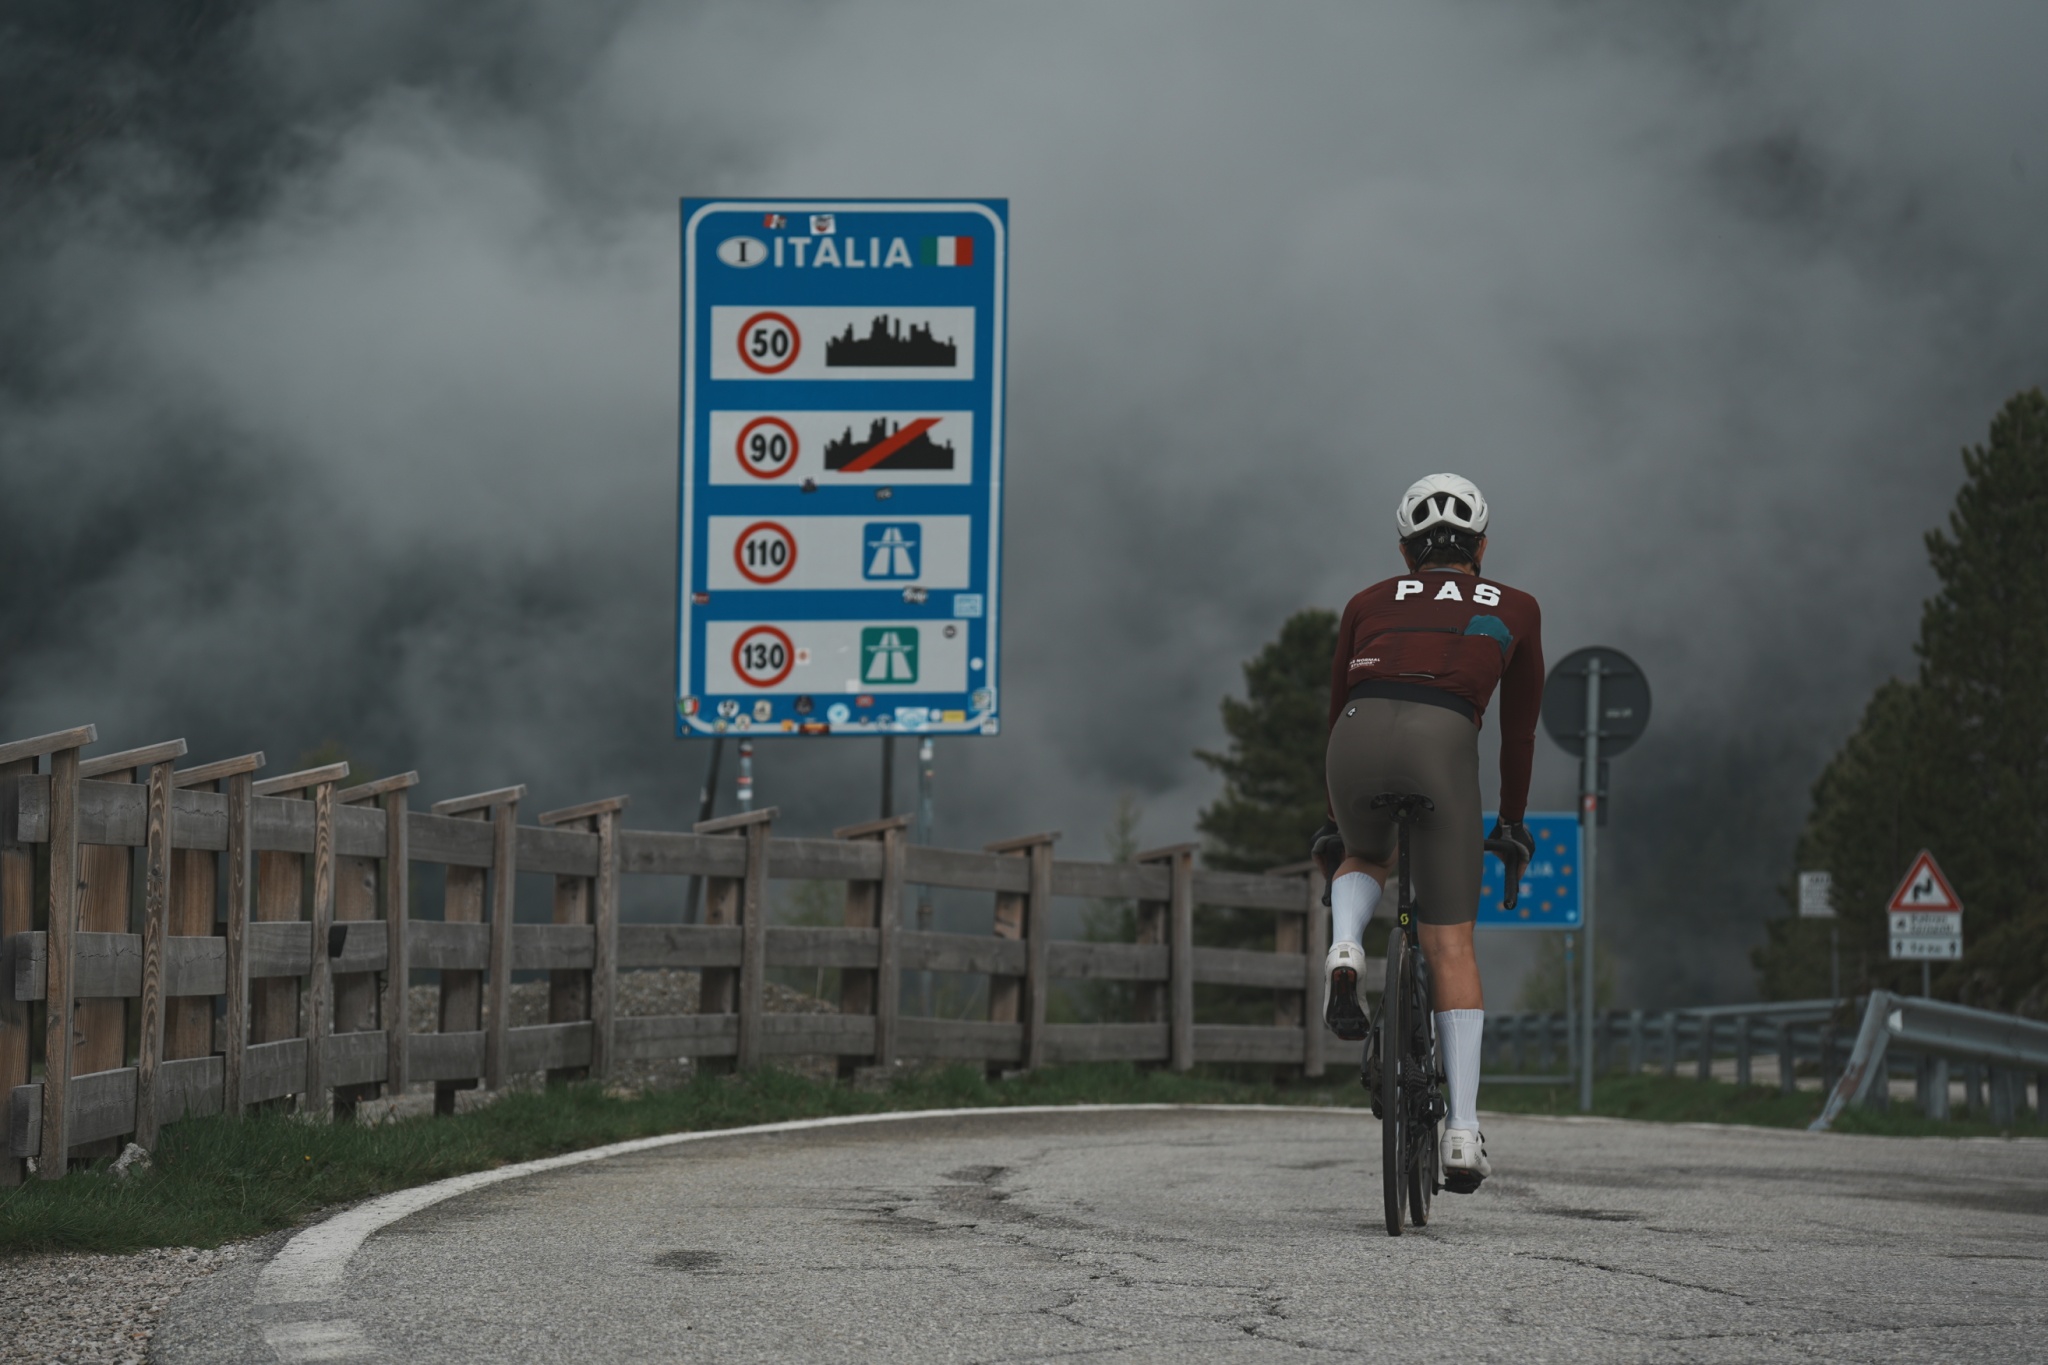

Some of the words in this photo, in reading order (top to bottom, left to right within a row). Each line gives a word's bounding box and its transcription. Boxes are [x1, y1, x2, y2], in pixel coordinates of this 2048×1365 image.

[737, 241, 747, 263] I
[774, 236, 913, 268] ITALIA
[752, 328, 789, 358] 50
[750, 433, 788, 463] 90
[746, 539, 787, 567] 110
[743, 643, 785, 671] 130
